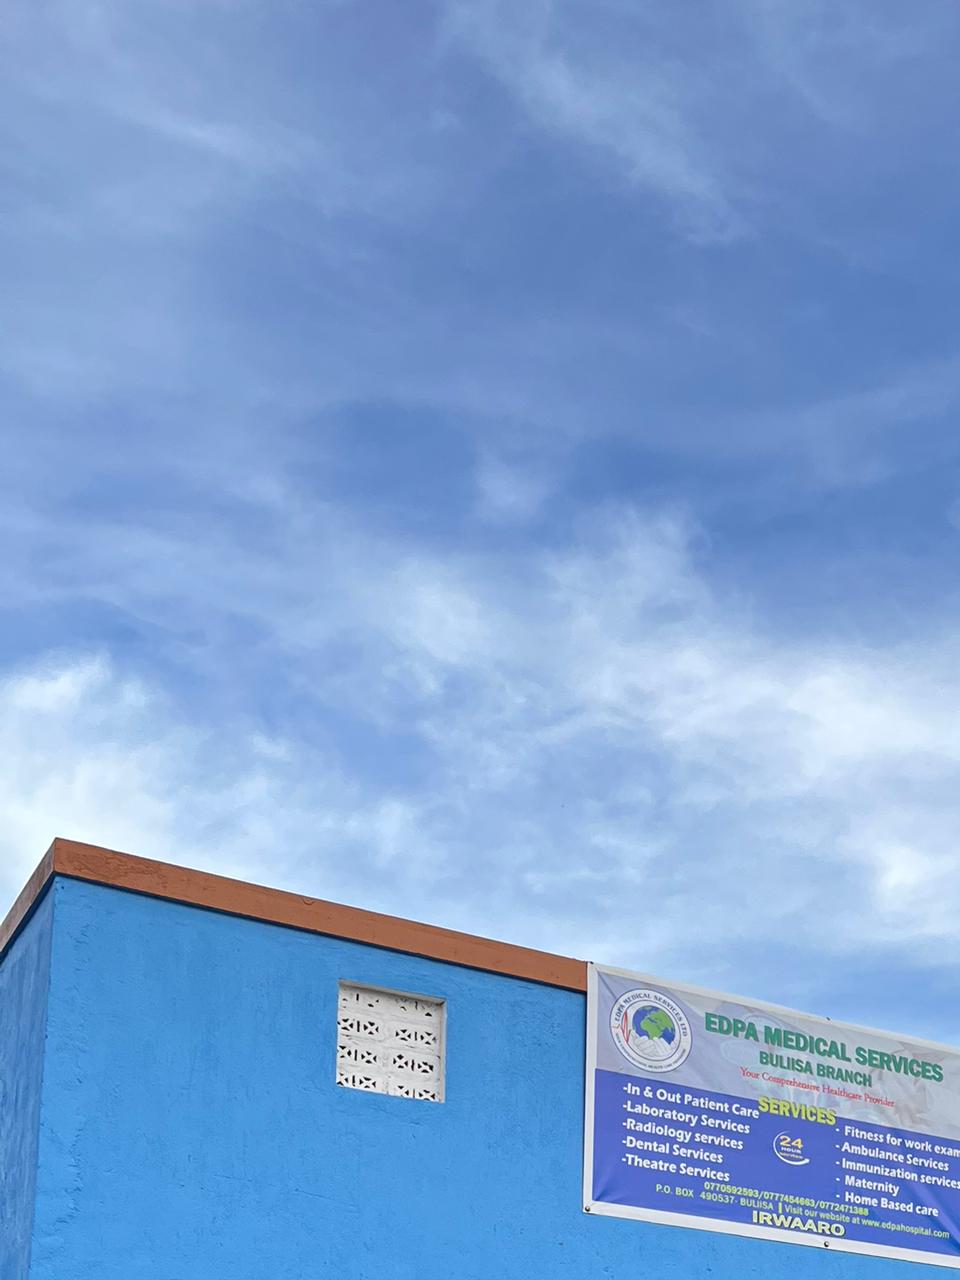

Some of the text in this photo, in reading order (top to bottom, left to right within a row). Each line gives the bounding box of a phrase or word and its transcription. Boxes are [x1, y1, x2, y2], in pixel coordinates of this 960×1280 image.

[624, 993, 652, 1004] MEDICAL
[654, 996, 682, 1021] SERVICES
[706, 1012, 943, 1082] EDPA MEDICAL SERVICES
[760, 1050, 872, 1087] BULIISA BRANCH
[740, 1067, 896, 1107] Your Comprehensive Healthcare Provider
[644, 1086, 653, 1097] &
[657, 1089, 682, 1103] Out
[685, 1093, 729, 1113] Patient
[732, 1105, 759, 1119] Care
[758, 1096, 837, 1126] SERVICES
[701, 1114, 750, 1134] Services
[695, 1132, 743, 1149] services
[780, 1135, 803, 1149] 24
[845, 1126, 883, 1143] Fitness
[886, 1131, 902, 1146] for
[906, 1136, 932, 1152] work
[672, 1145, 723, 1163] Services
[841, 1142, 904, 1163] Ambulance
[907, 1153, 949, 1171] Services
[680, 1163, 730, 1182] Services
[842, 1158, 917, 1182] Immunization
[845, 1175, 899, 1196] Maternity
[675, 1187, 694, 1197] BOX
[784, 1204, 802, 1216] Visit
[804, 1209, 818, 1219] our
[819, 1212, 850, 1223] website
[845, 1192, 878, 1207] Home
[881, 1200, 913, 1214] Based
[916, 1205, 939, 1217] care
[752, 1210, 846, 1237] IRWAARO
